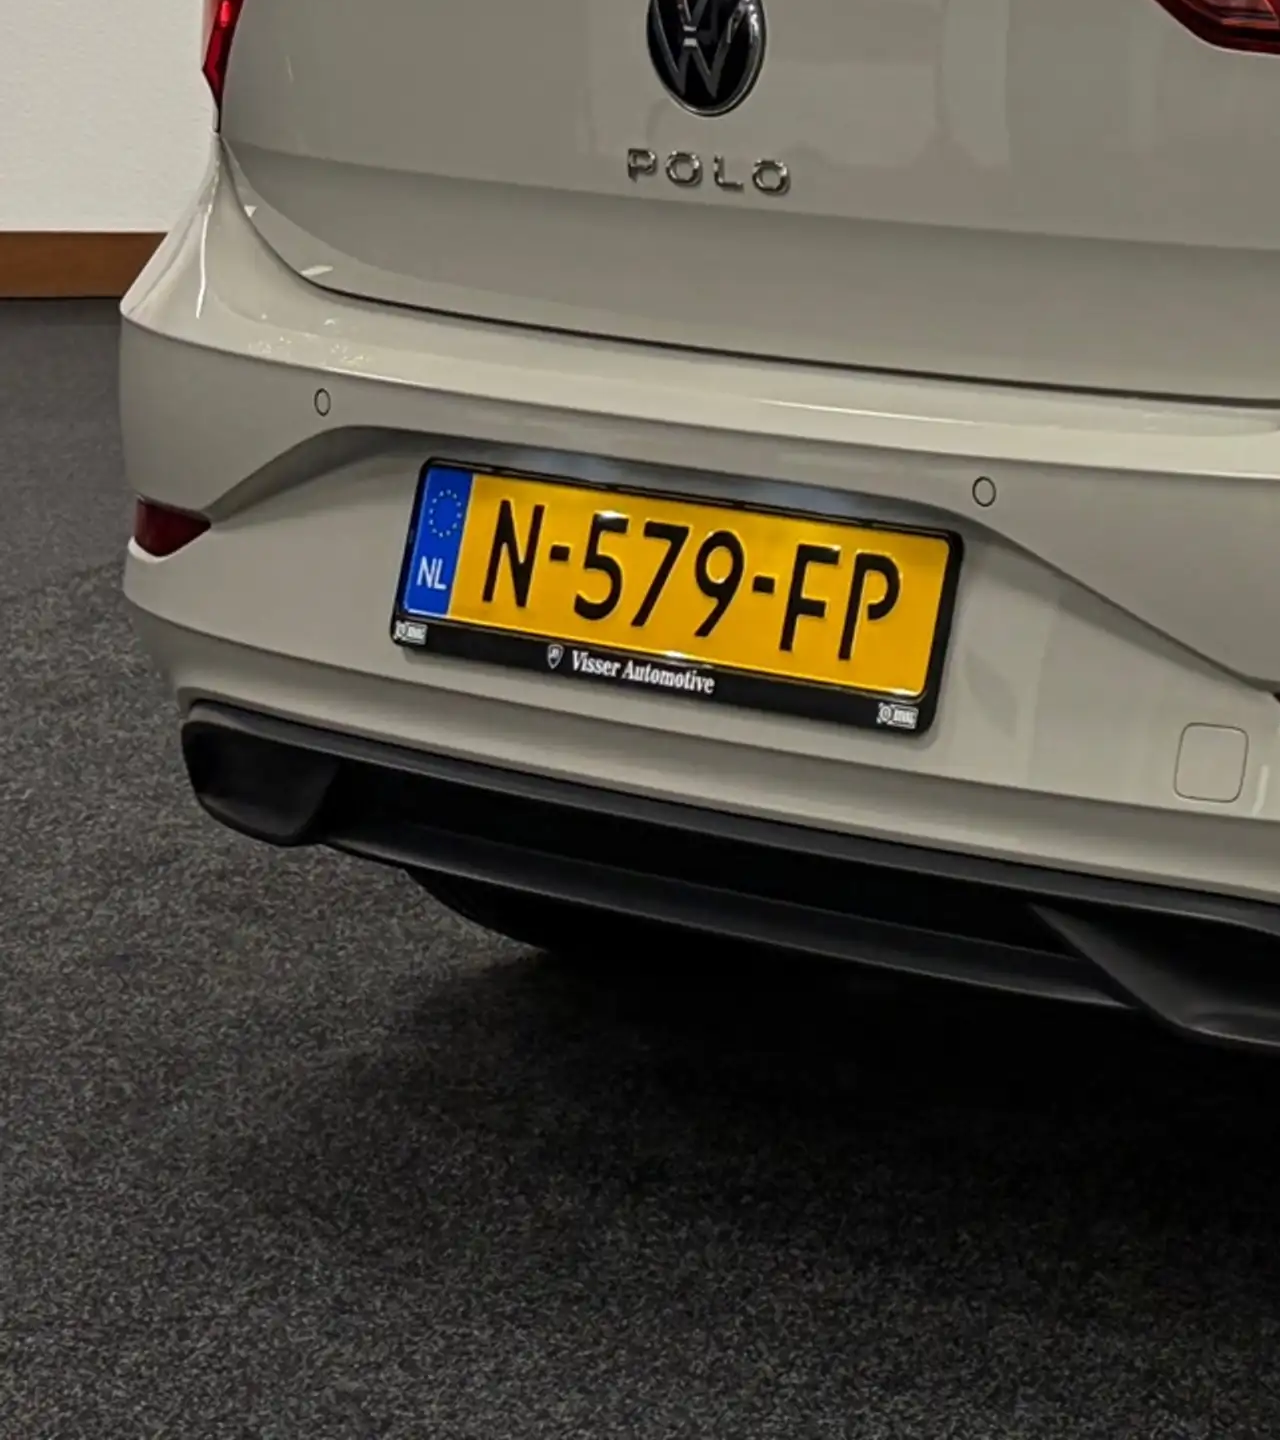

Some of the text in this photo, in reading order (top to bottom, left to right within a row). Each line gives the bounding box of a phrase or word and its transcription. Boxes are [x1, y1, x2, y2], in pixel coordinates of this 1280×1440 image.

[627, 148, 791, 194] POLO
[416, 556, 447, 591] NL
[482, 498, 901, 661] N-579-FP
[572, 650, 715, 694] Visser Automotive
